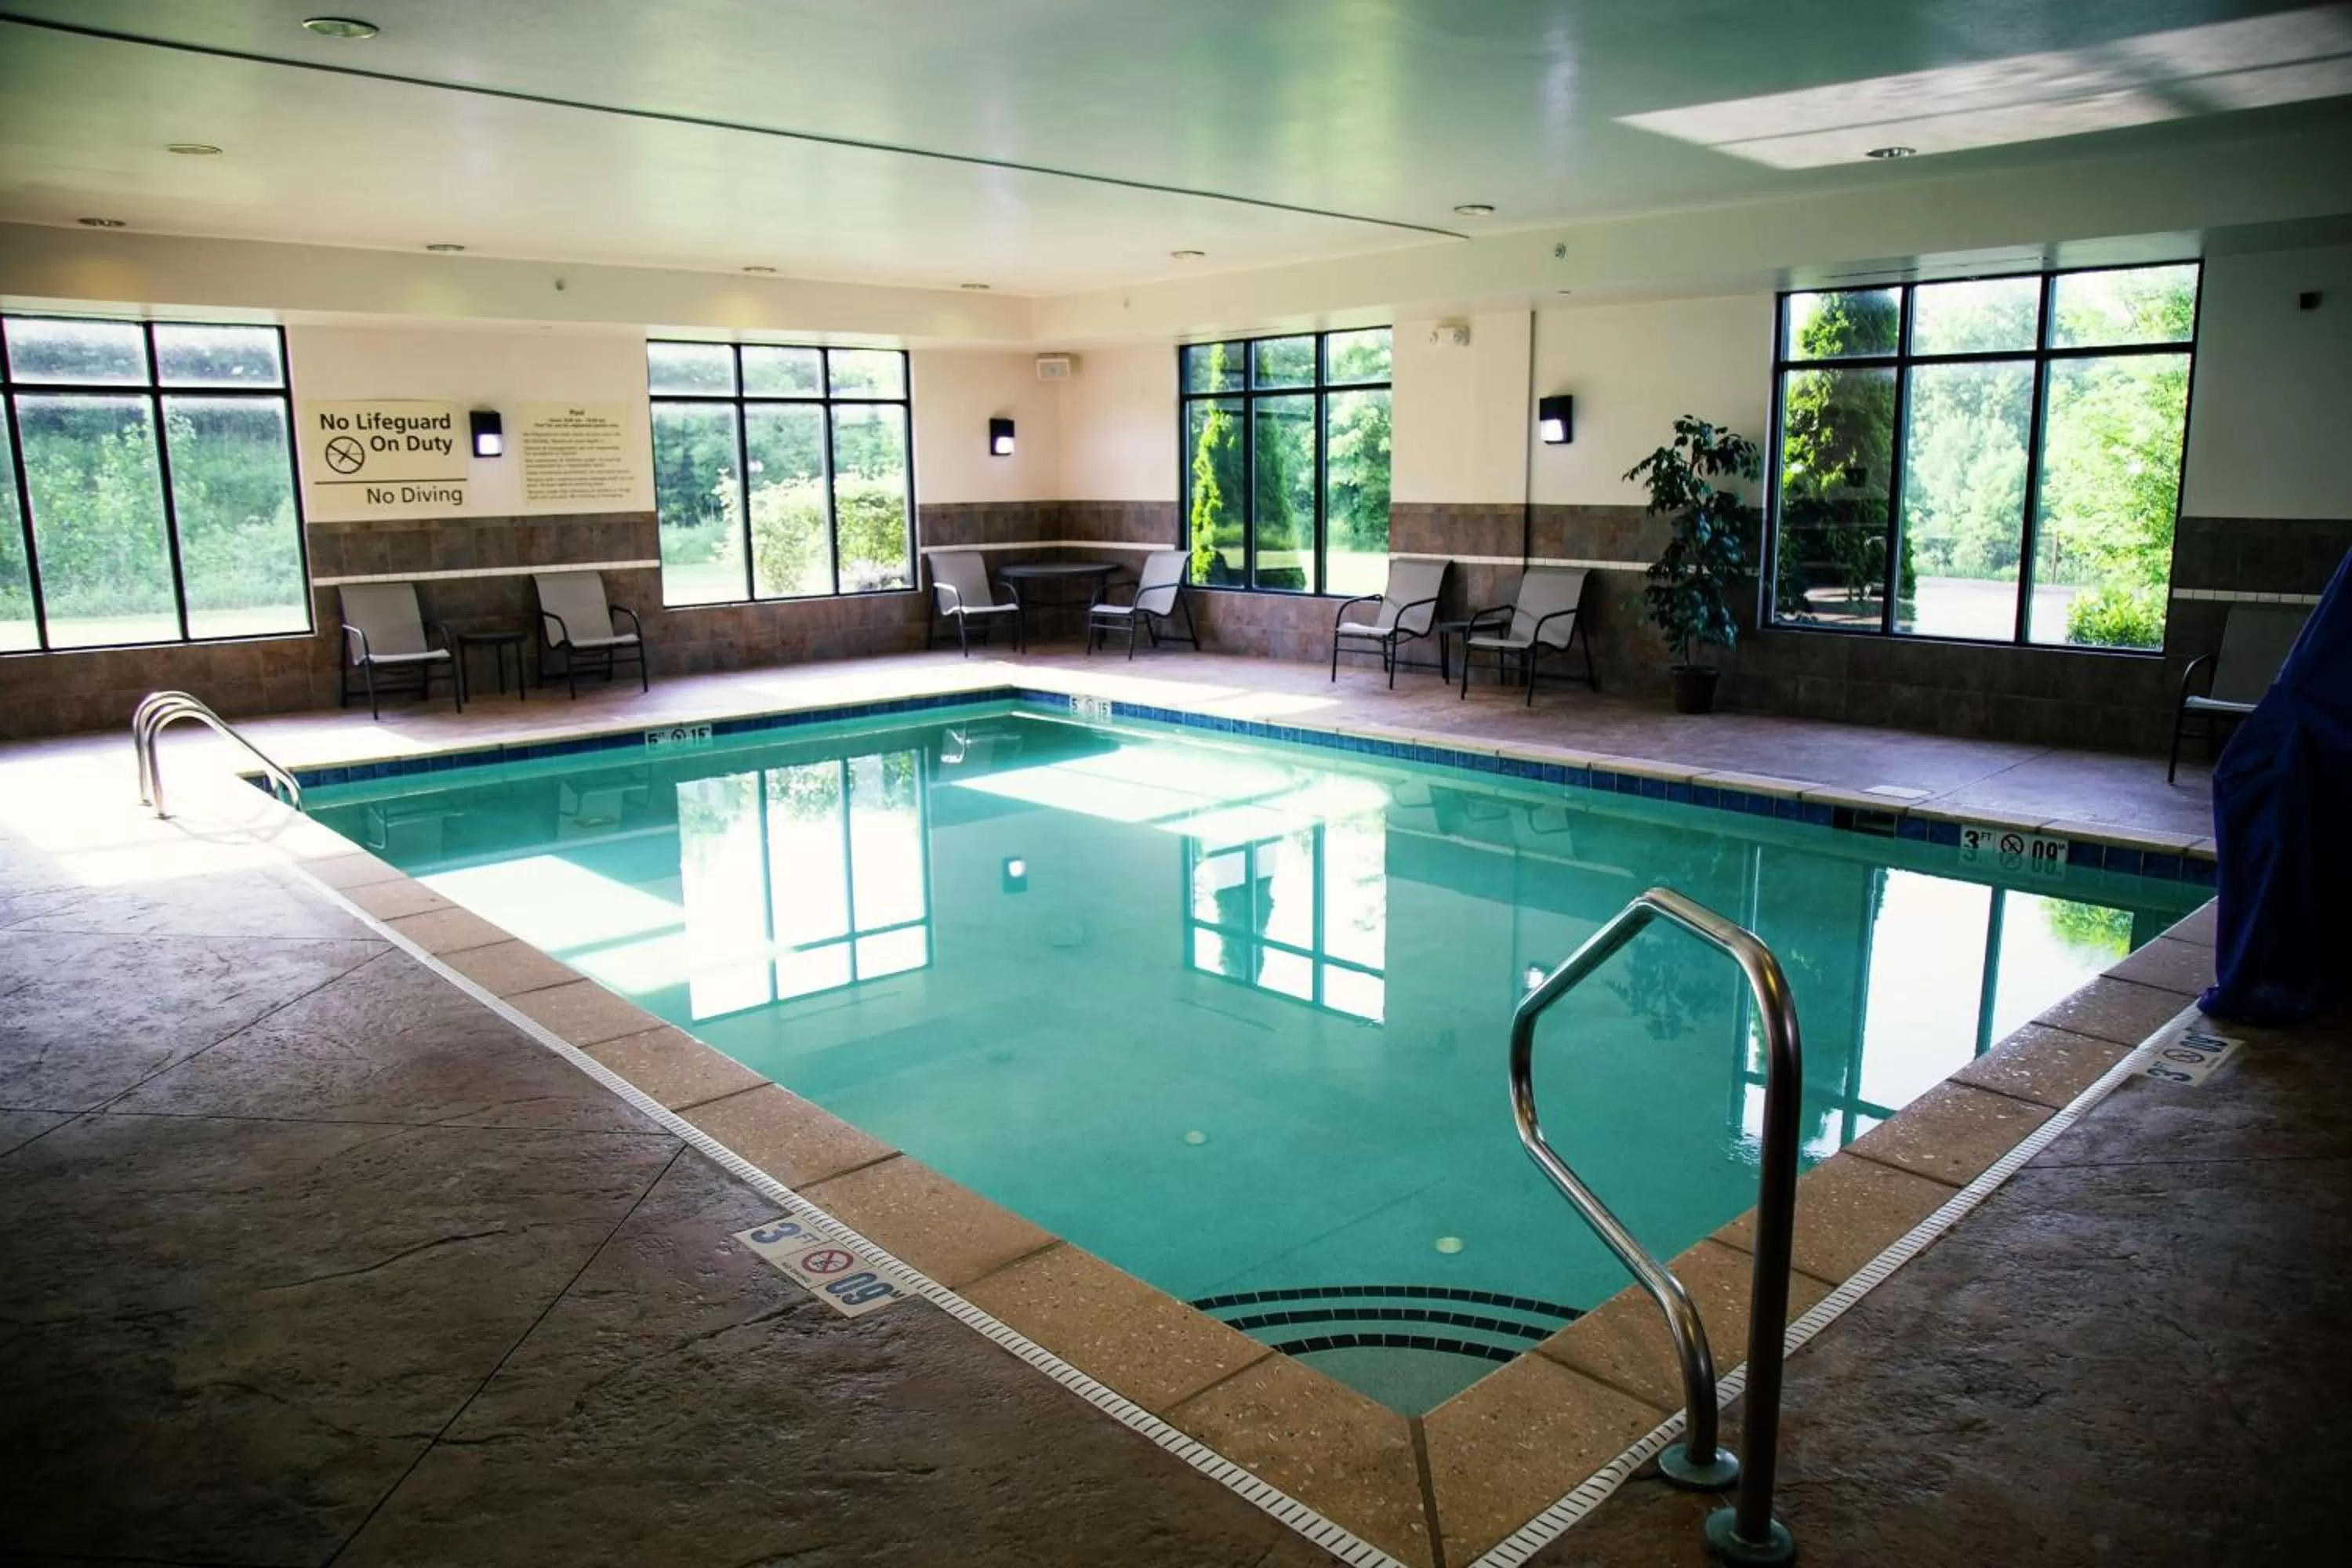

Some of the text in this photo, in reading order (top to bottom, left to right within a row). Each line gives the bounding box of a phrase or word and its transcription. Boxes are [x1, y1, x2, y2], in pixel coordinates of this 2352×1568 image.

[319, 412, 452, 434] No Lifeguard
[370, 435, 452, 456] On Duty
[366, 485, 463, 506] No Diving
[1964, 830, 1992, 849] 3 FT
[2147, 1067, 2193, 1081] 3
[750, 1222, 822, 1244] 3 FT
[889, 1290, 908, 1300] M
